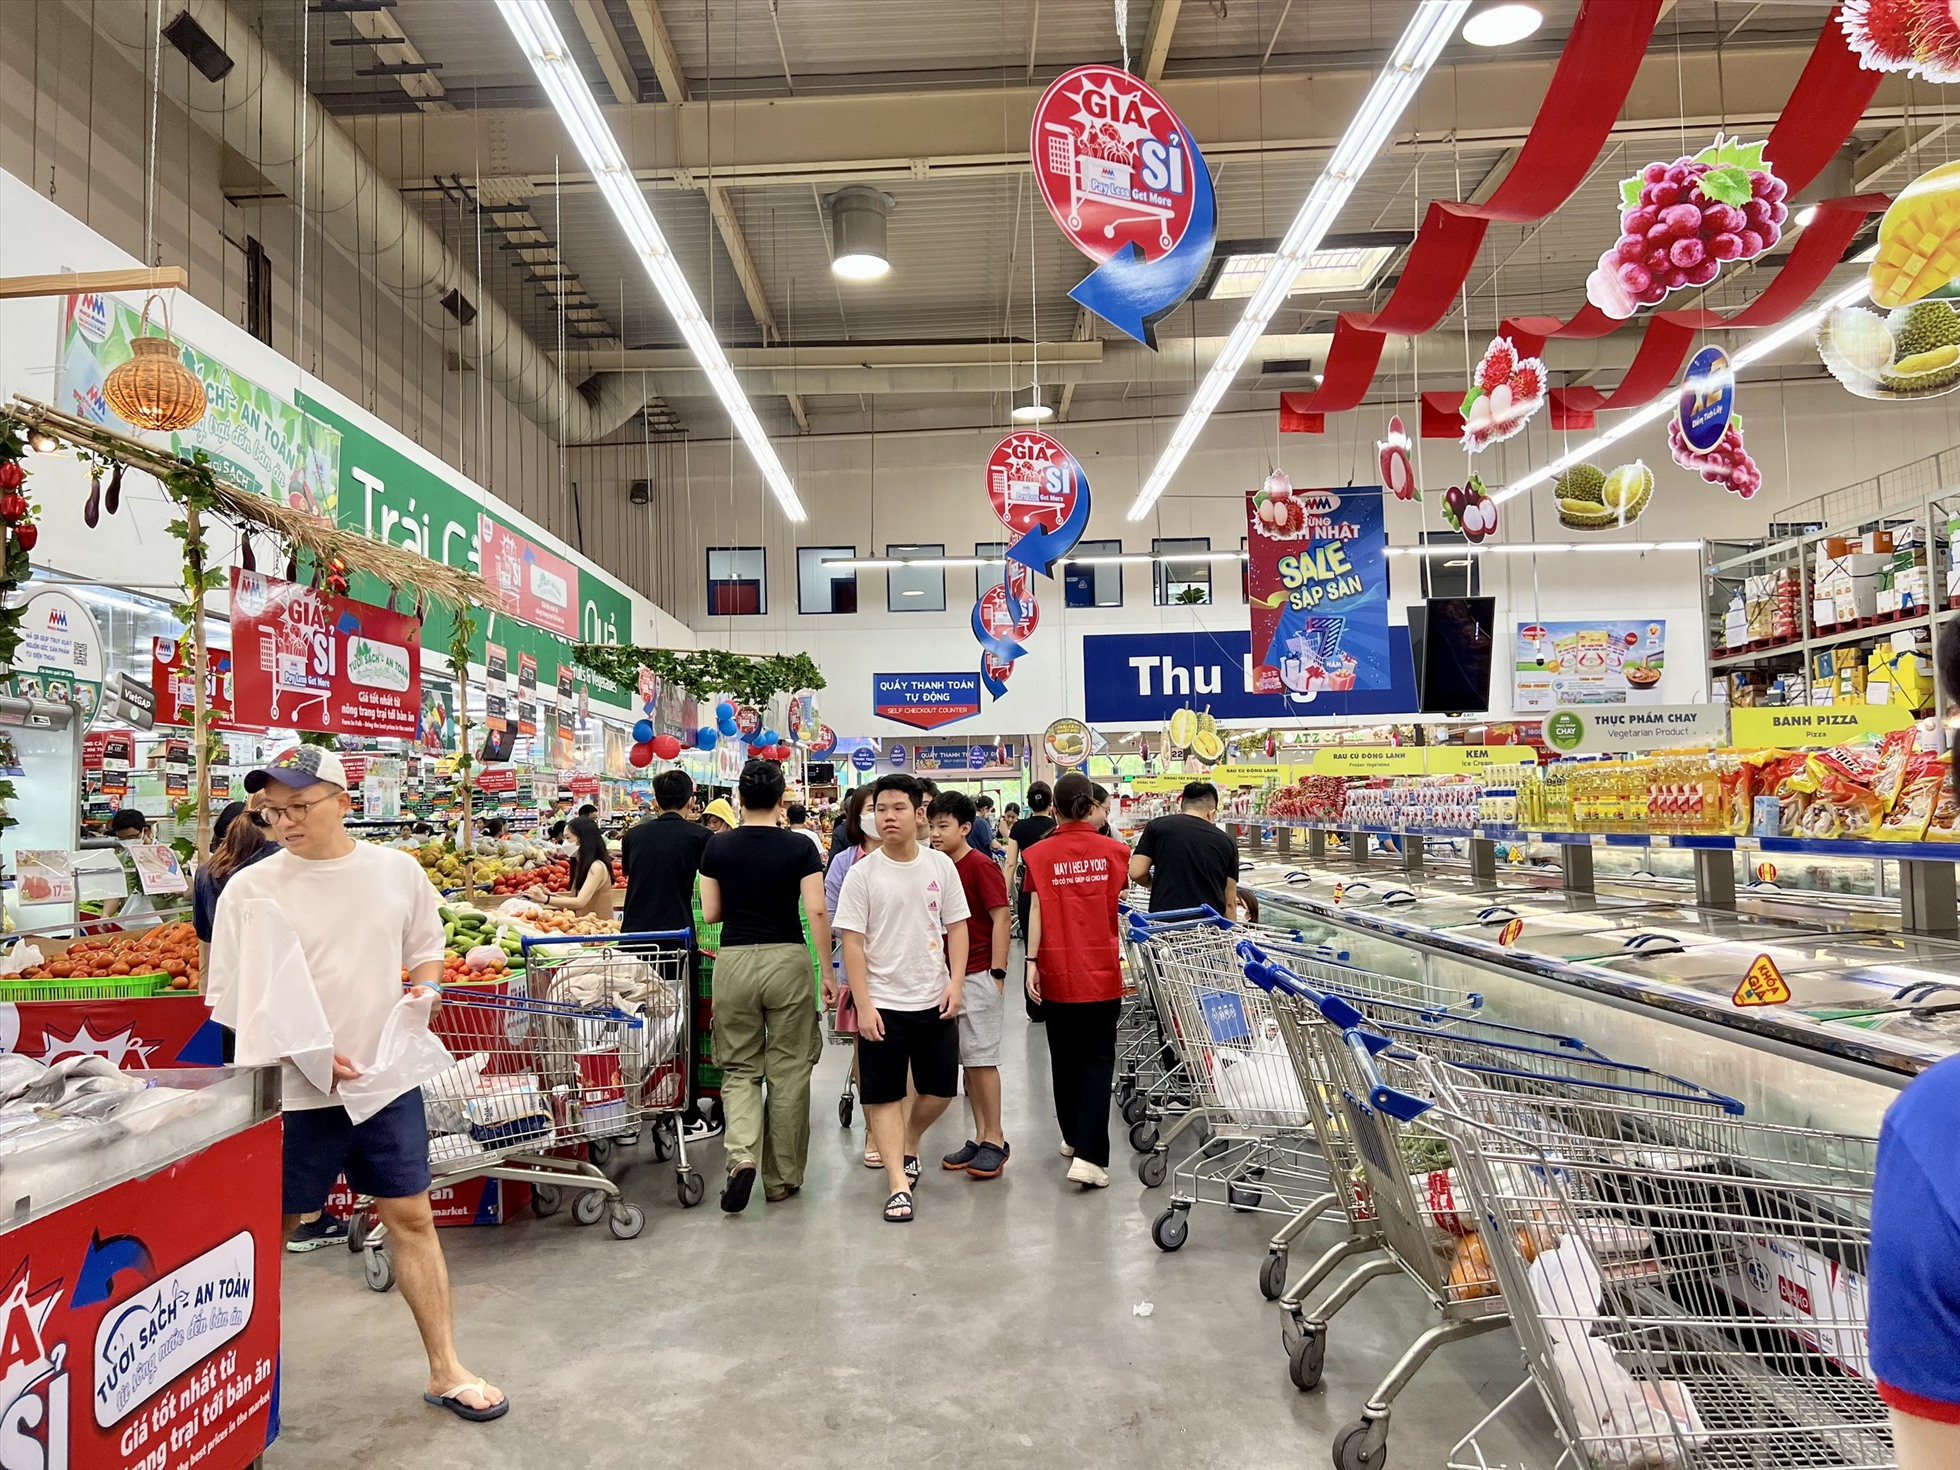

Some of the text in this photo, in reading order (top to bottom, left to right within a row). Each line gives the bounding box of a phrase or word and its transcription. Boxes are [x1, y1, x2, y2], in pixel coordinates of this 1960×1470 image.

[1081, 89, 1148, 129] GIÁ
[1141, 133, 1185, 194] SỈ
[1091, 179, 1172, 207] Pay Less Get More
[206, 382, 296, 472] CH AN TOÀN
[1011, 442, 1050, 461] GIÁ
[1045, 461, 1071, 494] SỈ
[1315, 522, 1361, 542] NHẬT
[1278, 540, 1352, 589] SALE
[1289, 574, 1363, 611] SẬP SÀN
[288, 598, 325, 630] GIÁ
[313, 624, 336, 677] SỈ
[385, 657, 394, 669] AN
[307, 675, 317, 685] Get
[316, 677, 331, 688] More
[911, 681, 944, 690] THANH
[1128, 655, 1221, 696] Thu
[124, 688, 151, 709] VietGAP
[358, 691, 369, 703] Giá
[369, 691, 380, 705] tốt
[379, 693, 393, 707] nhất
[341, 702, 358, 718] nông
[358, 705, 376, 720] trang
[1594, 715, 1625, 727] THỰC
[1667, 713, 1698, 723] CHAY
[1816, 714, 1859, 726] PIZZA
[1607, 727, 1689, 740] Vegetarian Product
[1171, 750, 1183, 758] 22
[1465, 750, 1489, 758] KEM
[1472, 759, 1494, 767] Cream
[1053, 858, 1107, 876] MAY I HELP YOU?
[53, 885, 62, 898] 17
[1749, 975, 1770, 1001] GIÁ
[1757, 963, 1780, 996] KHÓA
[431, 1206, 468, 1216] market
[138, 1300, 178, 1351] SẠCH
[193, 1282, 214, 1309] AN
[219, 1272, 250, 1300] TOÀN
[119, 1349, 238, 1457] Giá tốt nhất từ
[169, 1406, 200, 1449] trại
[201, 1386, 224, 1427] tới
[226, 1374, 252, 1411] bàn
[254, 1356, 272, 1390] ăn
[188, 1441, 208, 1468] best
[207, 1428, 229, 1459] prices
[228, 1419, 237, 1434] in
[236, 1409, 249, 1428] the
[248, 1389, 272, 1421] market
